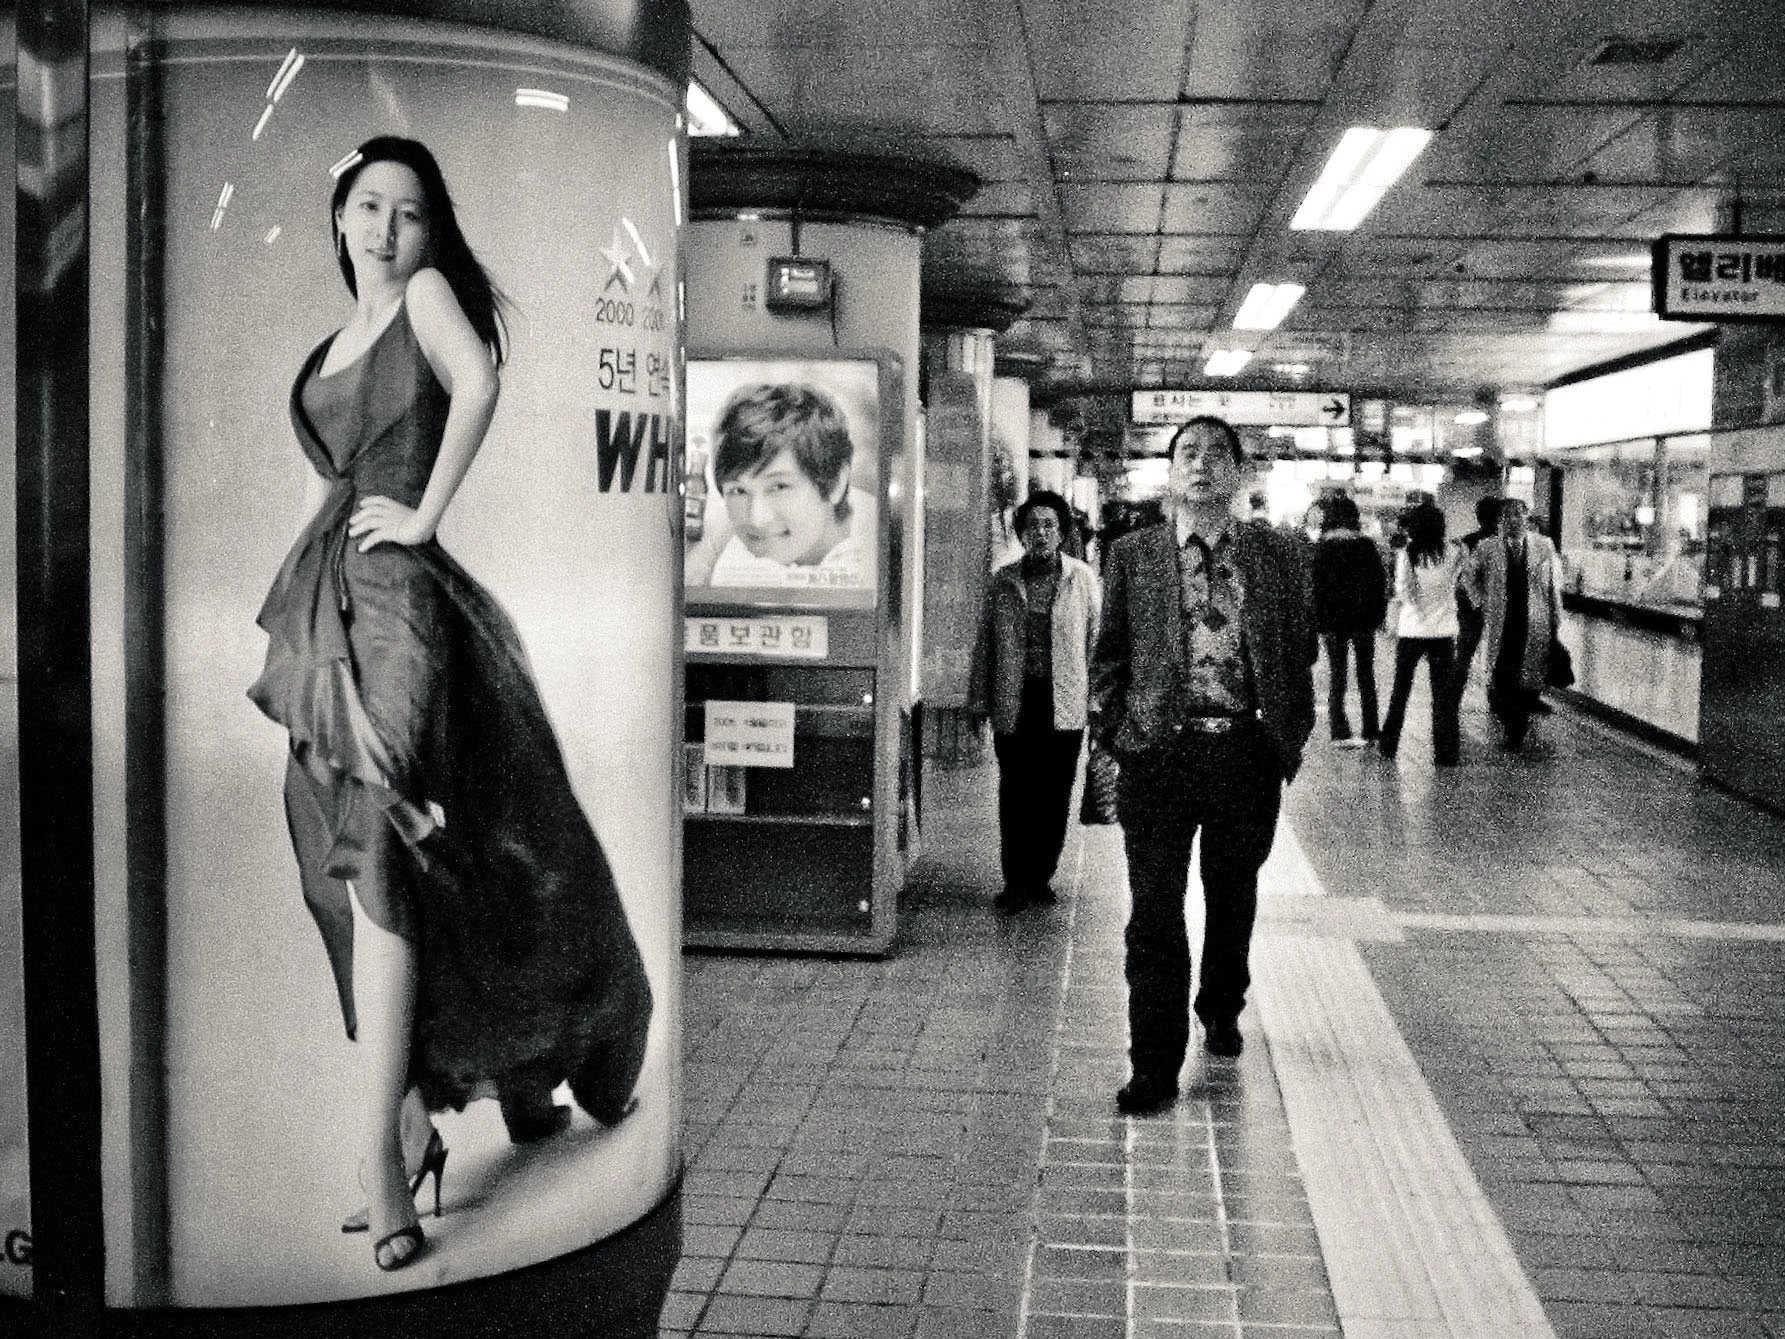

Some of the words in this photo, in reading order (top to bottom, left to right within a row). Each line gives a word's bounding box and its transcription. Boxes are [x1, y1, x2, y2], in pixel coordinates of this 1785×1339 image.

[1681, 287, 1759, 302] Elevator
[595, 297, 635, 327] 2000
[597, 347, 636, 395] 5년
[684, 622, 812, 649] 품보관함
[0, 1228, 33, 1266] G
